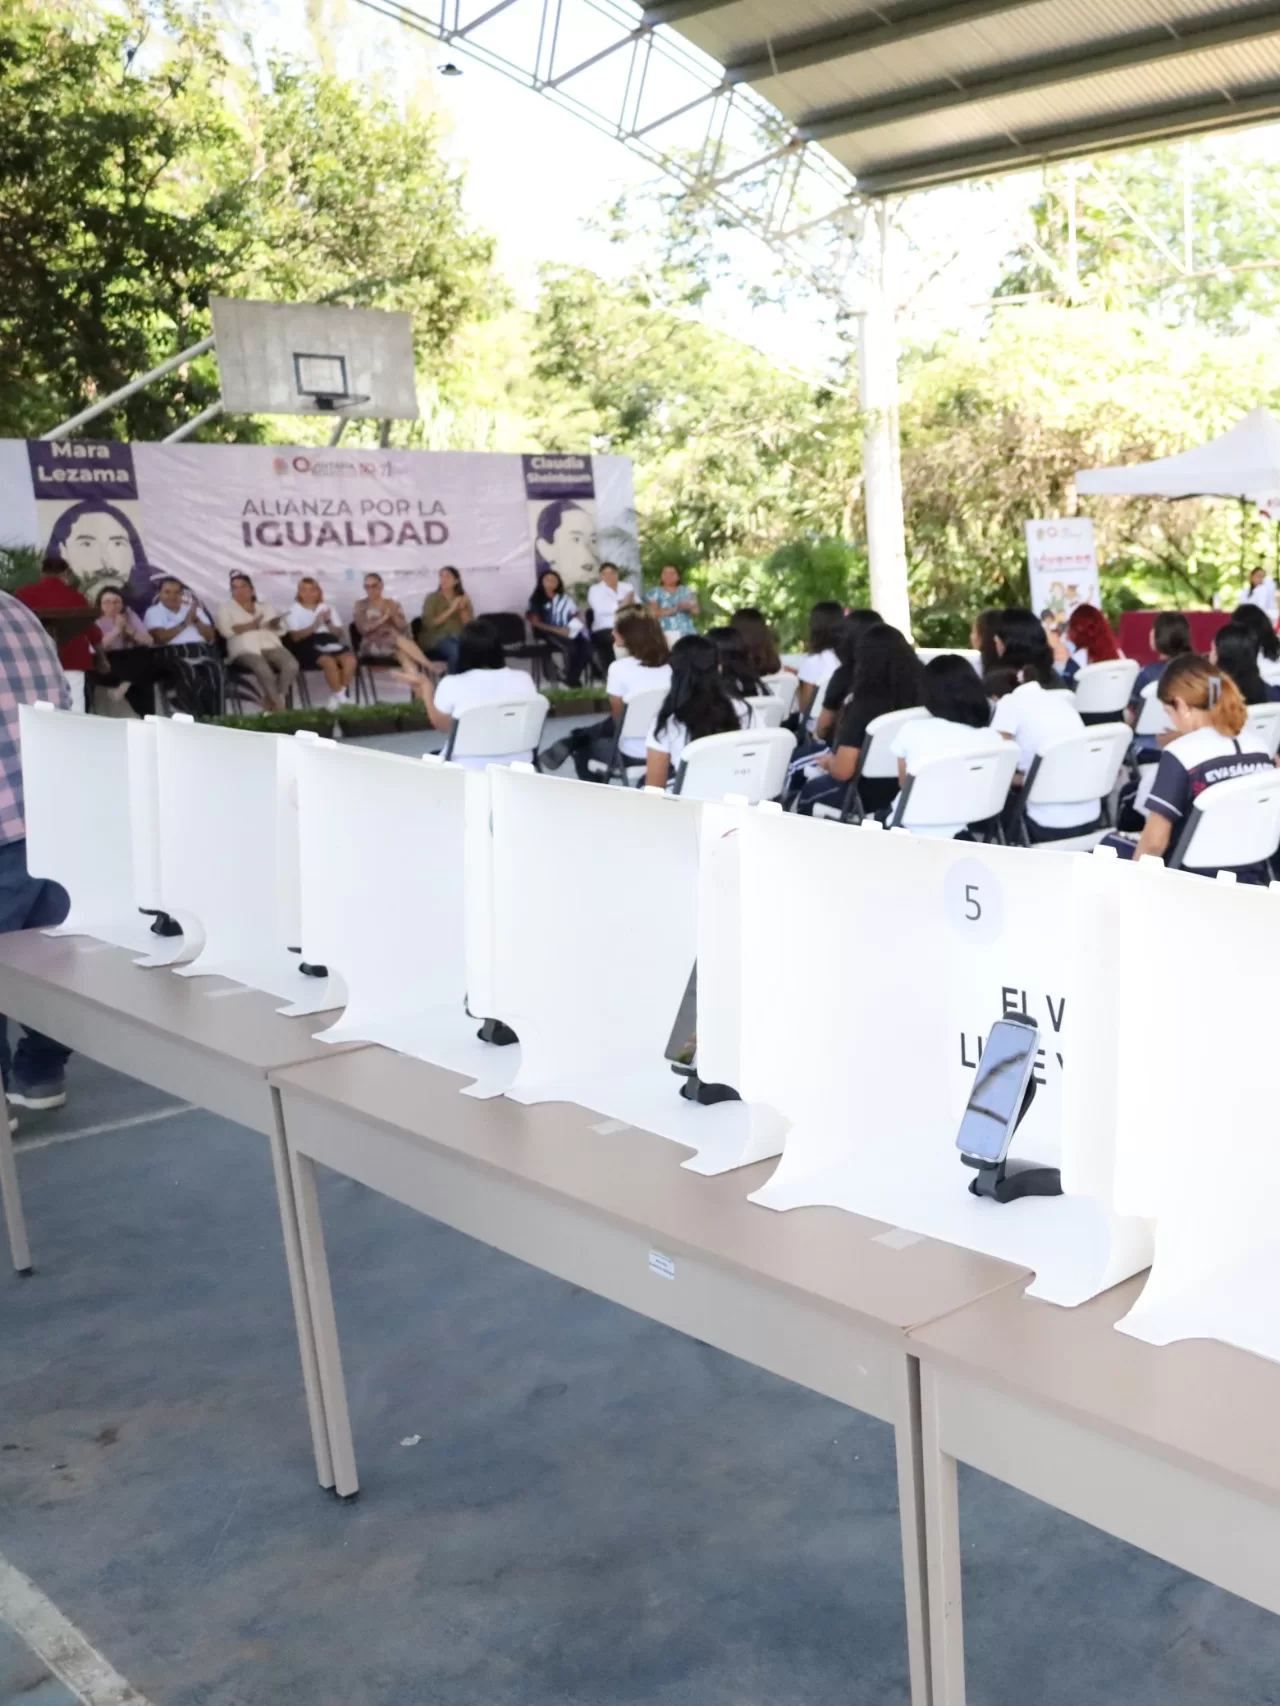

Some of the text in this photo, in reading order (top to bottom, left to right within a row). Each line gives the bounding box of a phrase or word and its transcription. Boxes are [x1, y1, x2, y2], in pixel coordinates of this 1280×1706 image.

[50, 441, 111, 459] Mara
[37, 464, 130, 483] Lezama
[241, 498, 448, 518] ALIANZA POR LA
[240, 519, 450, 549] IGUALDAD
[965, 884, 982, 921] 5
